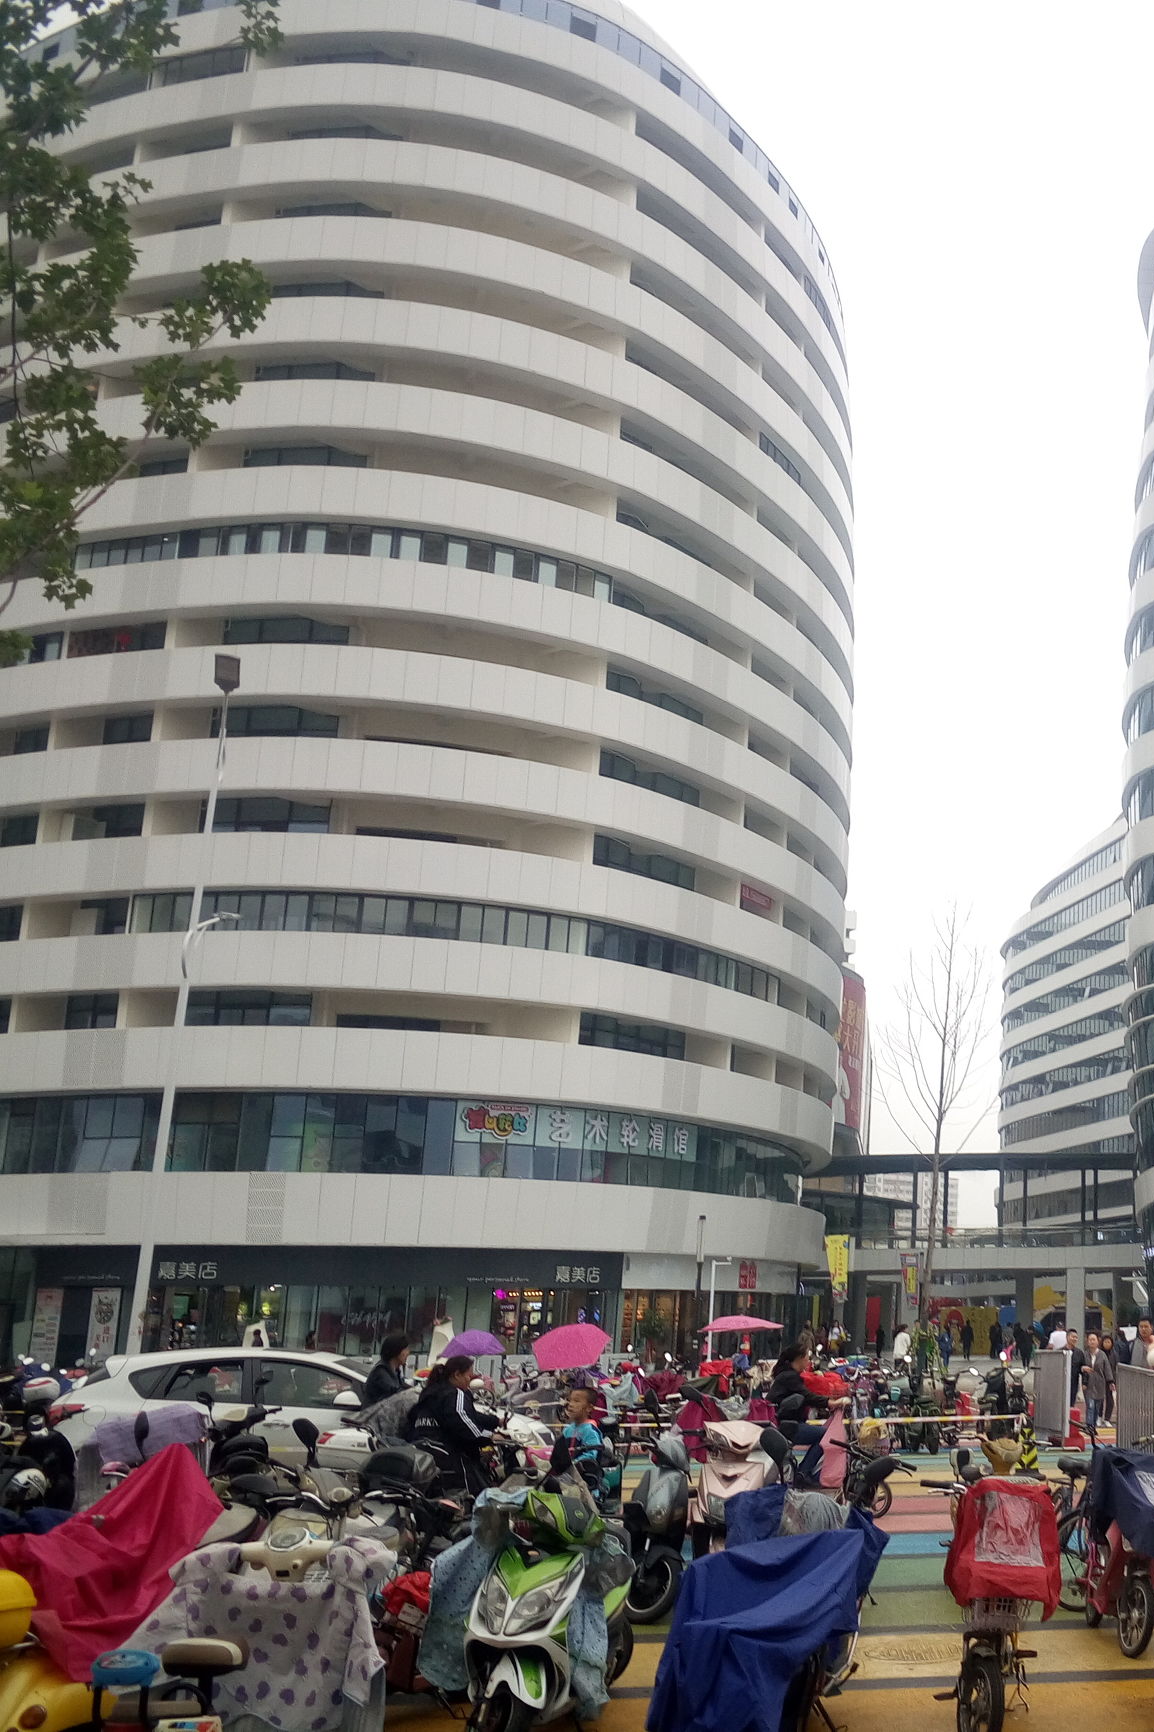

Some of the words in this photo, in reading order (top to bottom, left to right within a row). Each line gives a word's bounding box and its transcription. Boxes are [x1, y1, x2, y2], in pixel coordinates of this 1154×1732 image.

[550, 1110, 689, 1155] 艺术轮滑馆
